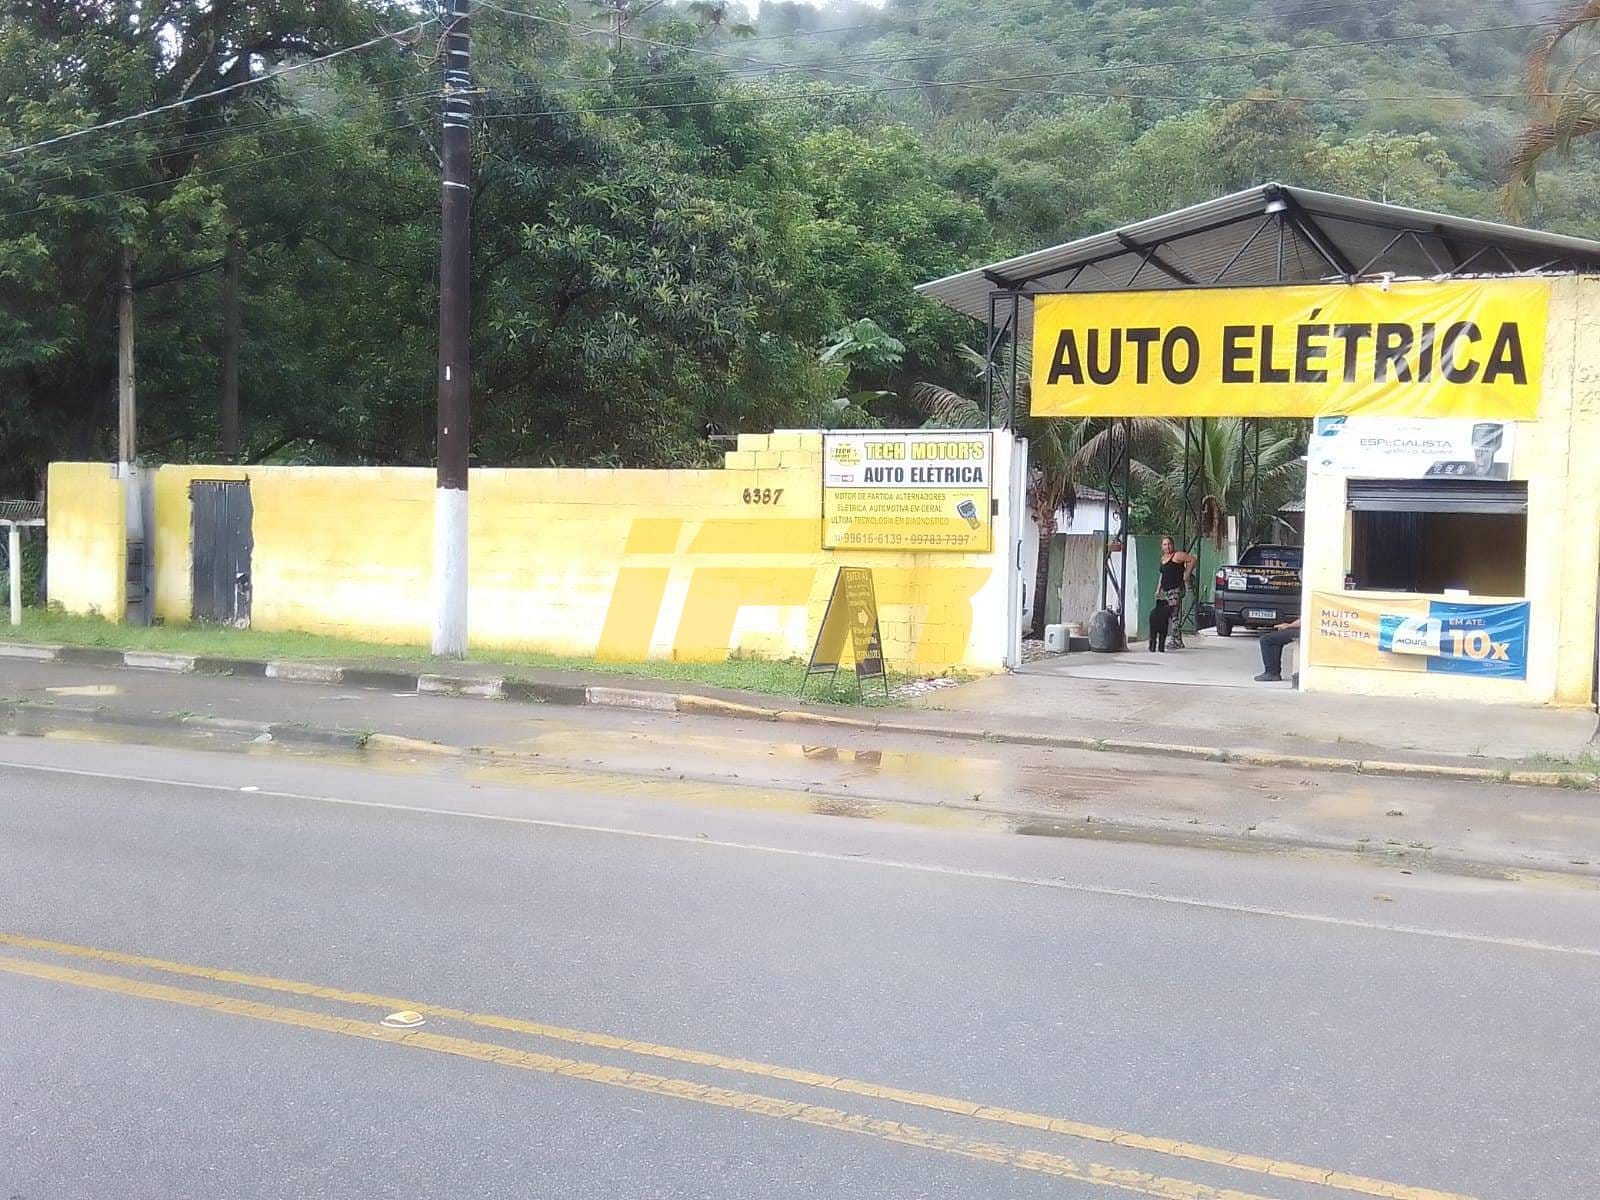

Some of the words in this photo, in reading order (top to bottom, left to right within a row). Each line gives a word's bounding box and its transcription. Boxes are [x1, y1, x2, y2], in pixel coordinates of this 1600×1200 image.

[1047, 326, 1201, 385] AUTO
[1222, 308, 1528, 386] ELÉTRICA
[1359, 438, 1453, 449] ESPECIALISTA
[864, 441, 906, 461] TECH
[911, 440, 985, 461] MOTOR'S
[863, 466, 905, 483] AUTO
[911, 464, 984, 483] ELÉTRICA
[742, 487, 785, 505] 6387
[834, 492, 857, 501] MOTOR
[857, 492, 867, 501] DE
[867, 492, 894, 501] PARTIDA
[895, 492, 947, 501] ALTERNADORES
[869, 504, 909, 513] AUTOMOTIVA
[910, 504, 920, 513] EM
[920, 504, 943, 513] GERAL
[854, 516, 893, 525] TECNOLOGIA
[1320, 609, 1360, 620] MUITO
[1320, 619, 1350, 629] MAIS
[1449, 618, 1464, 626] EM
[1320, 629, 1371, 640] BATERIA
[1449, 629, 1510, 661] 10x
